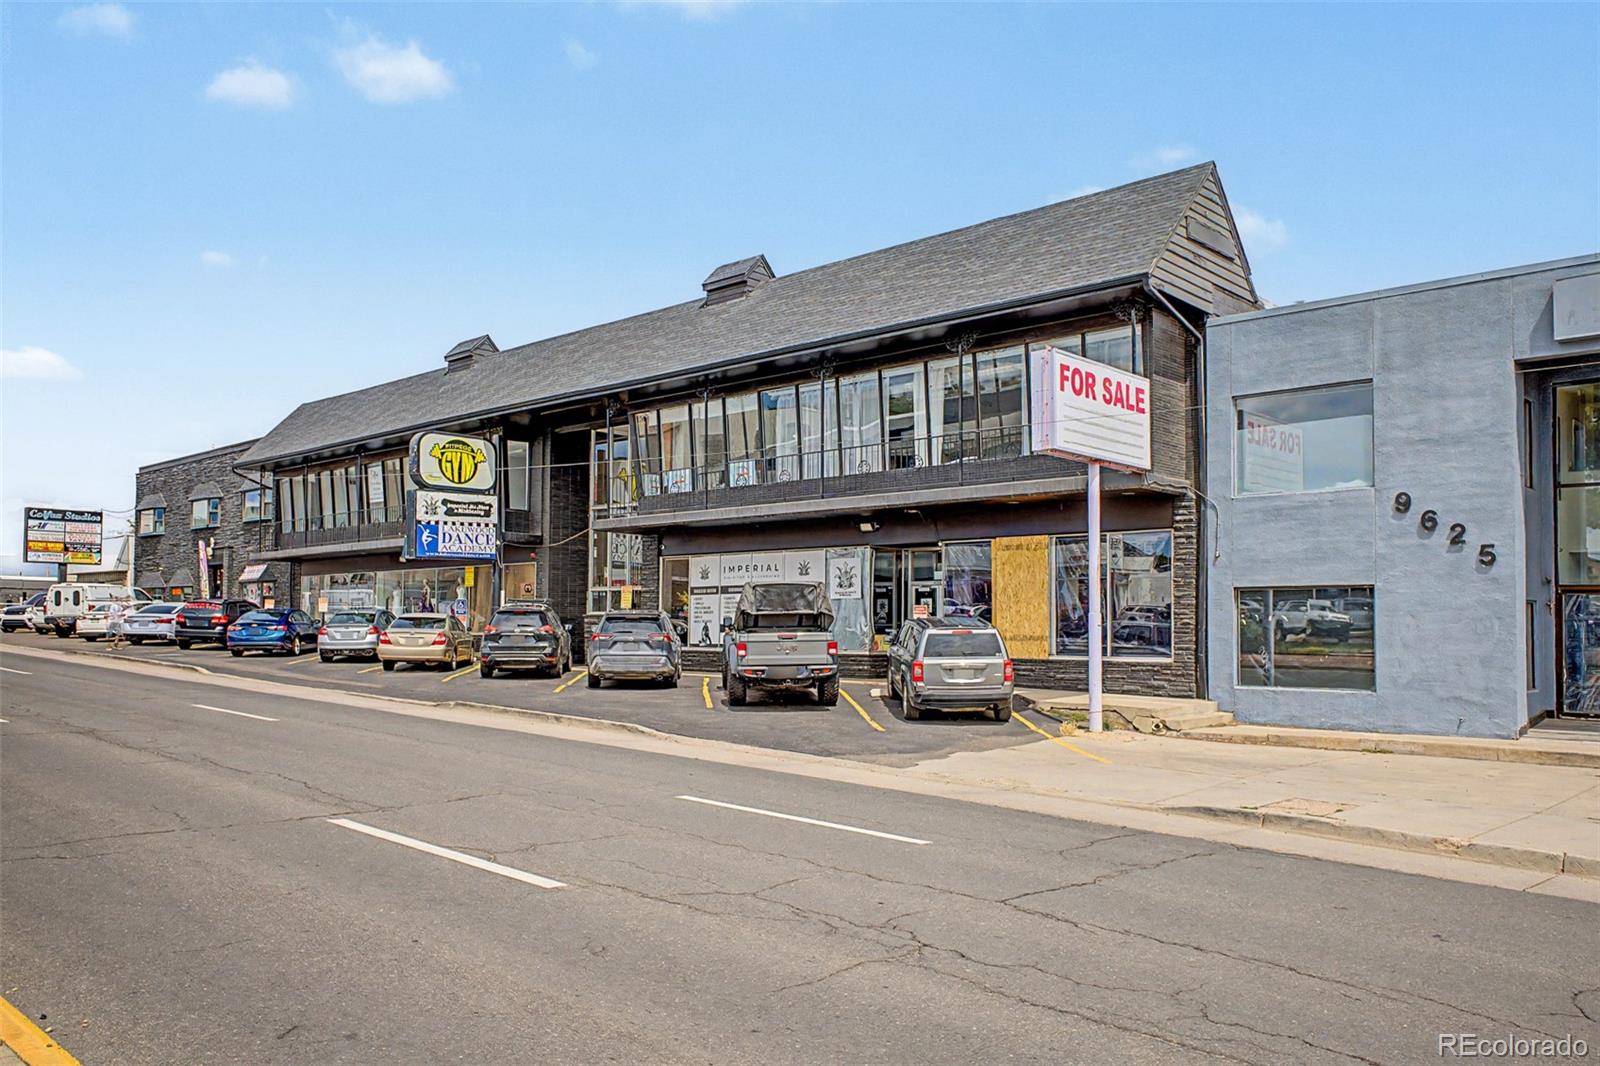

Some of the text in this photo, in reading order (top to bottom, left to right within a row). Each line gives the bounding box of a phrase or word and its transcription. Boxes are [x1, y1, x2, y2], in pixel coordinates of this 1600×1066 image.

[1059, 363, 1145, 414] FOR SALE
[442, 452, 475, 482] GYM
[64, 512, 100, 521] Studios
[442, 526, 495, 534] LAKEWOOD
[1395, 492, 1496, 566] 9625
[442, 532, 494, 546] DANCE
[441, 544, 494, 553] ACADEMY
[723, 563, 780, 574] IMPERIAL
